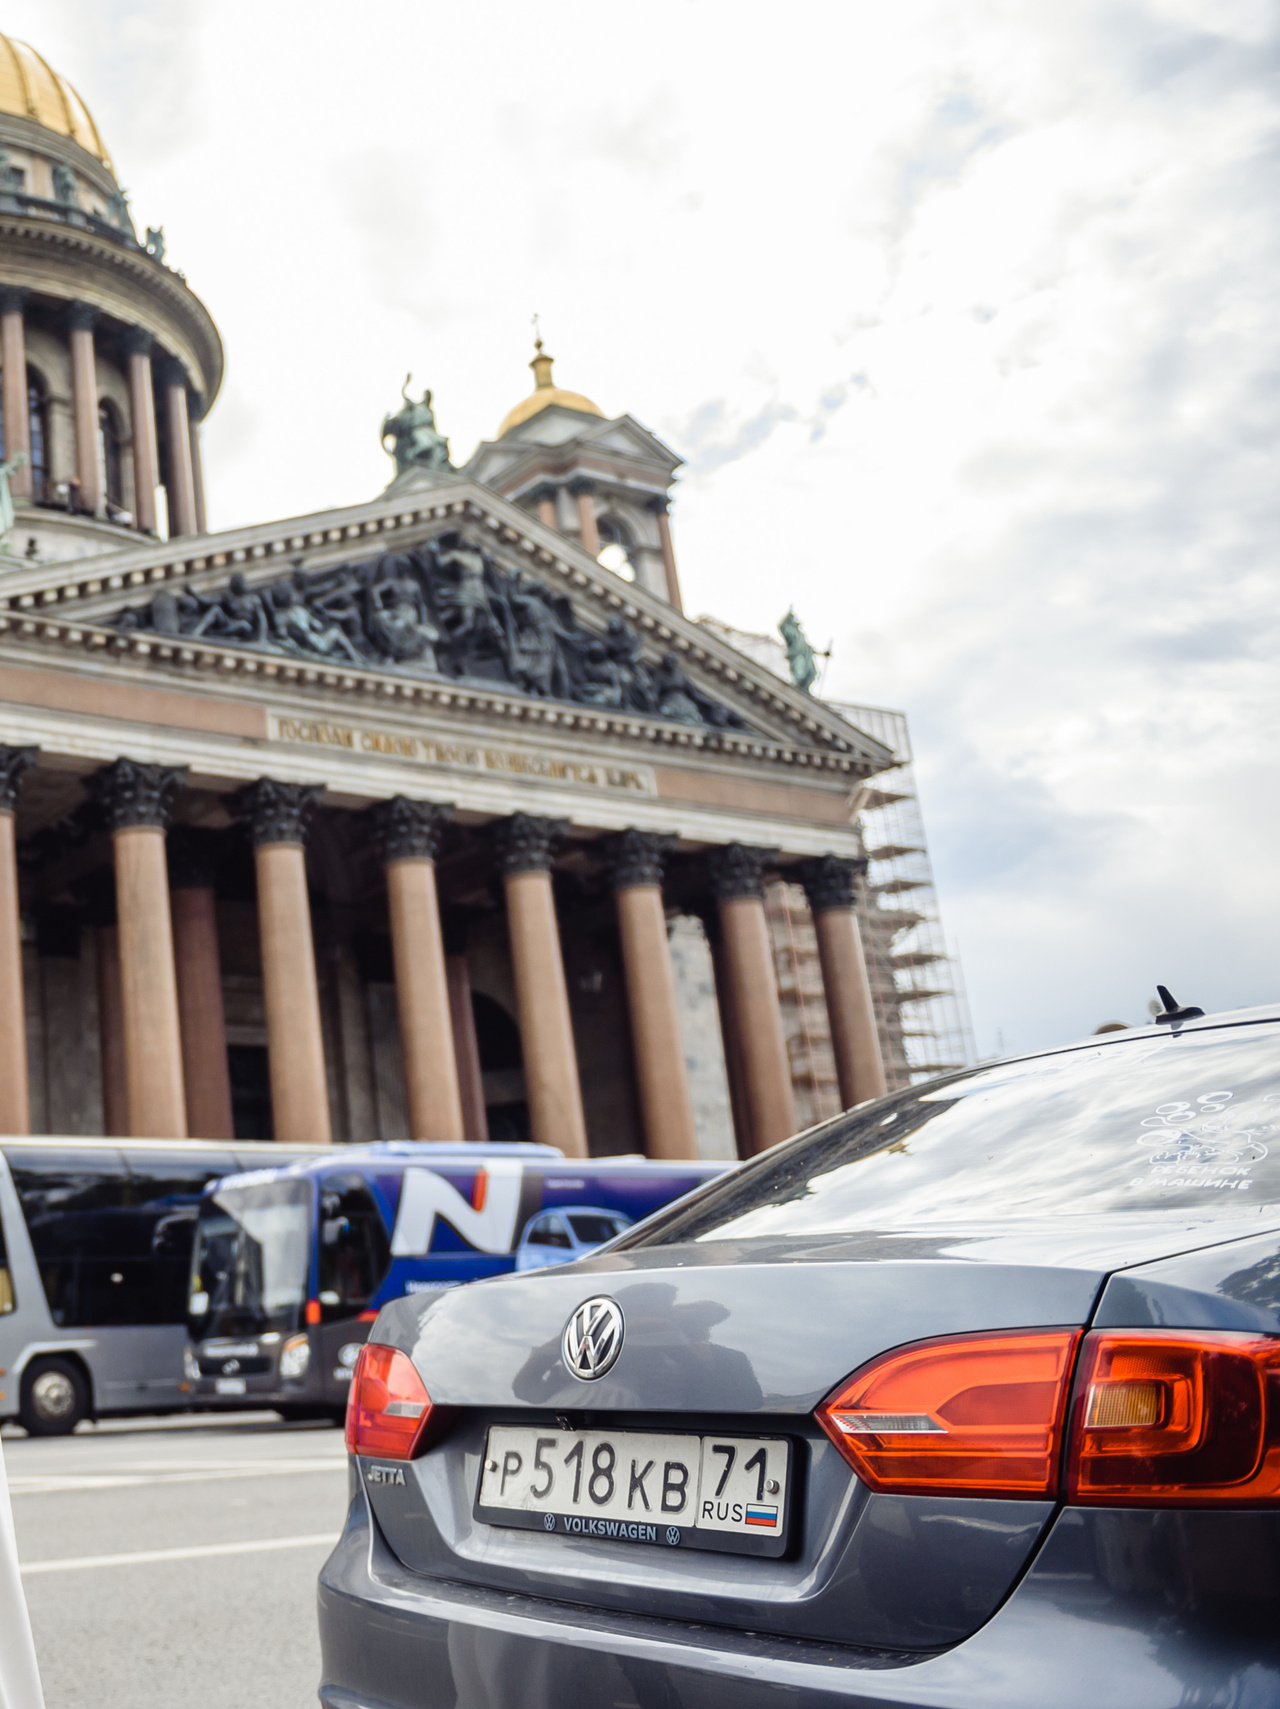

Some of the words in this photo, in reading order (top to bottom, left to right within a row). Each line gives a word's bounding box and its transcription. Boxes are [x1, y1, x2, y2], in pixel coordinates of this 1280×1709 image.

[1150, 1166, 1251, 1176] РЕБЕНОК
[1149, 1178, 1254, 1190] МАШИНЕ
[367, 1465, 406, 1486] JETTA
[711, 1443, 767, 1502] 71
[702, 1500, 743, 1523] RUS
[563, 1516, 657, 1541] VOLKSWAGEN
